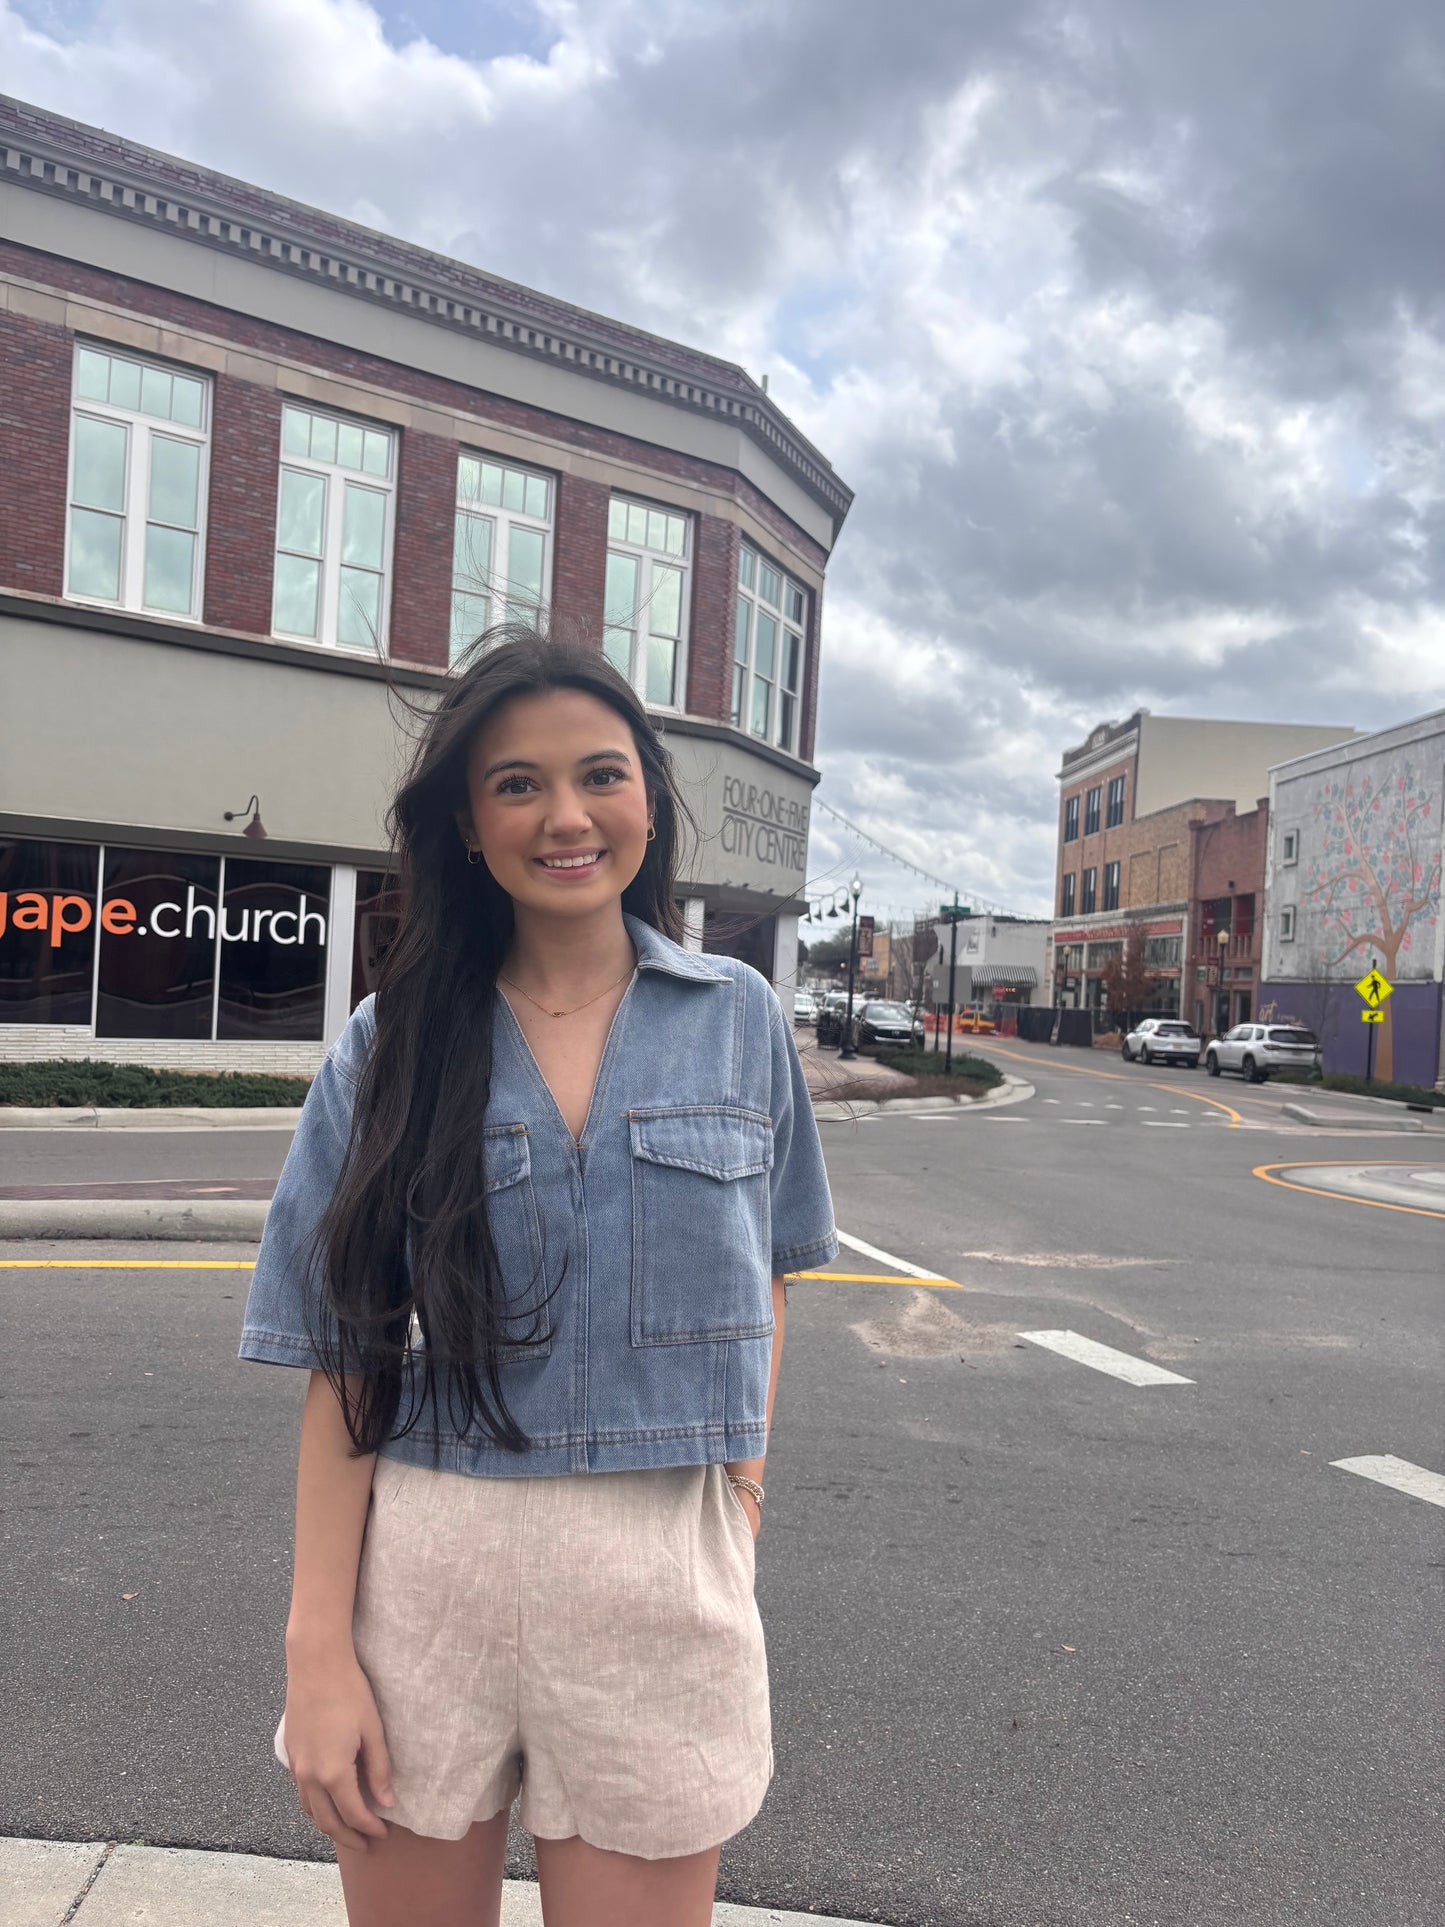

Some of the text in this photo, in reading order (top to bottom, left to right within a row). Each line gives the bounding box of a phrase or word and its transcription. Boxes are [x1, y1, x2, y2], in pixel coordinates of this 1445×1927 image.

[721, 814, 806, 872] CITY CENTRE
[0, 885, 326, 948] ape.church
